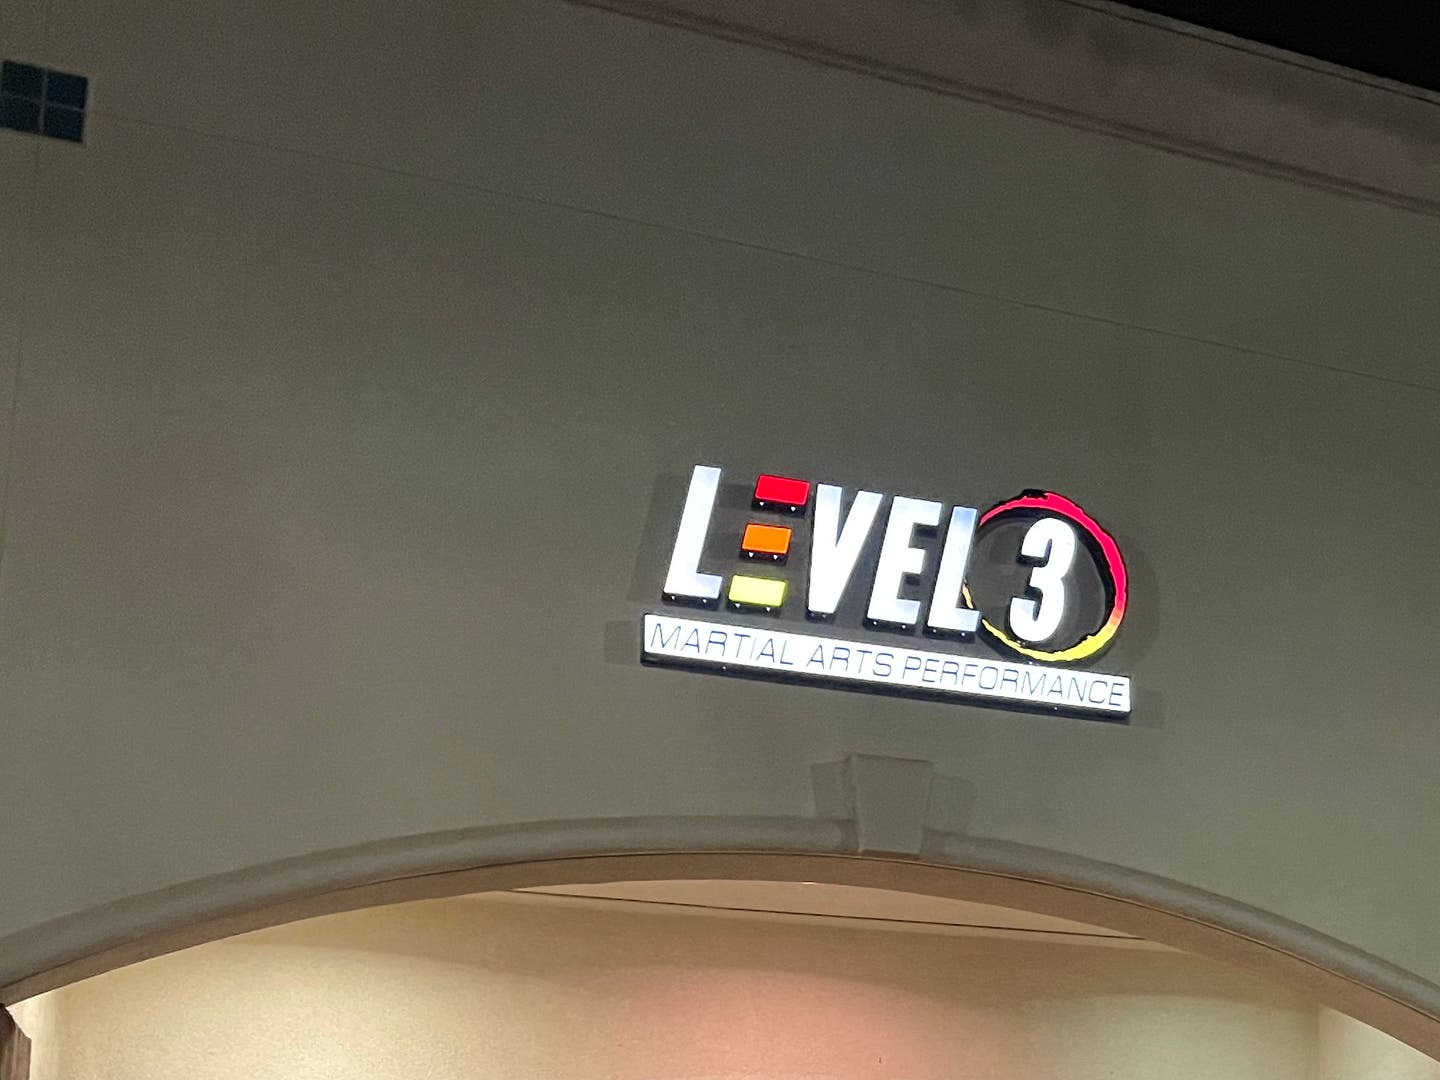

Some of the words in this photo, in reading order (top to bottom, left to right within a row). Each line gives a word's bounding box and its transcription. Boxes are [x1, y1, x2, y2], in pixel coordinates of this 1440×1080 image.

[663, 465, 980, 632] LEVEL
[1009, 517, 1077, 642] 3
[649, 623, 795, 665] MARTIAL
[807, 643, 893, 677] ARTS
[902, 655, 1129, 707] PERFORMANCE
